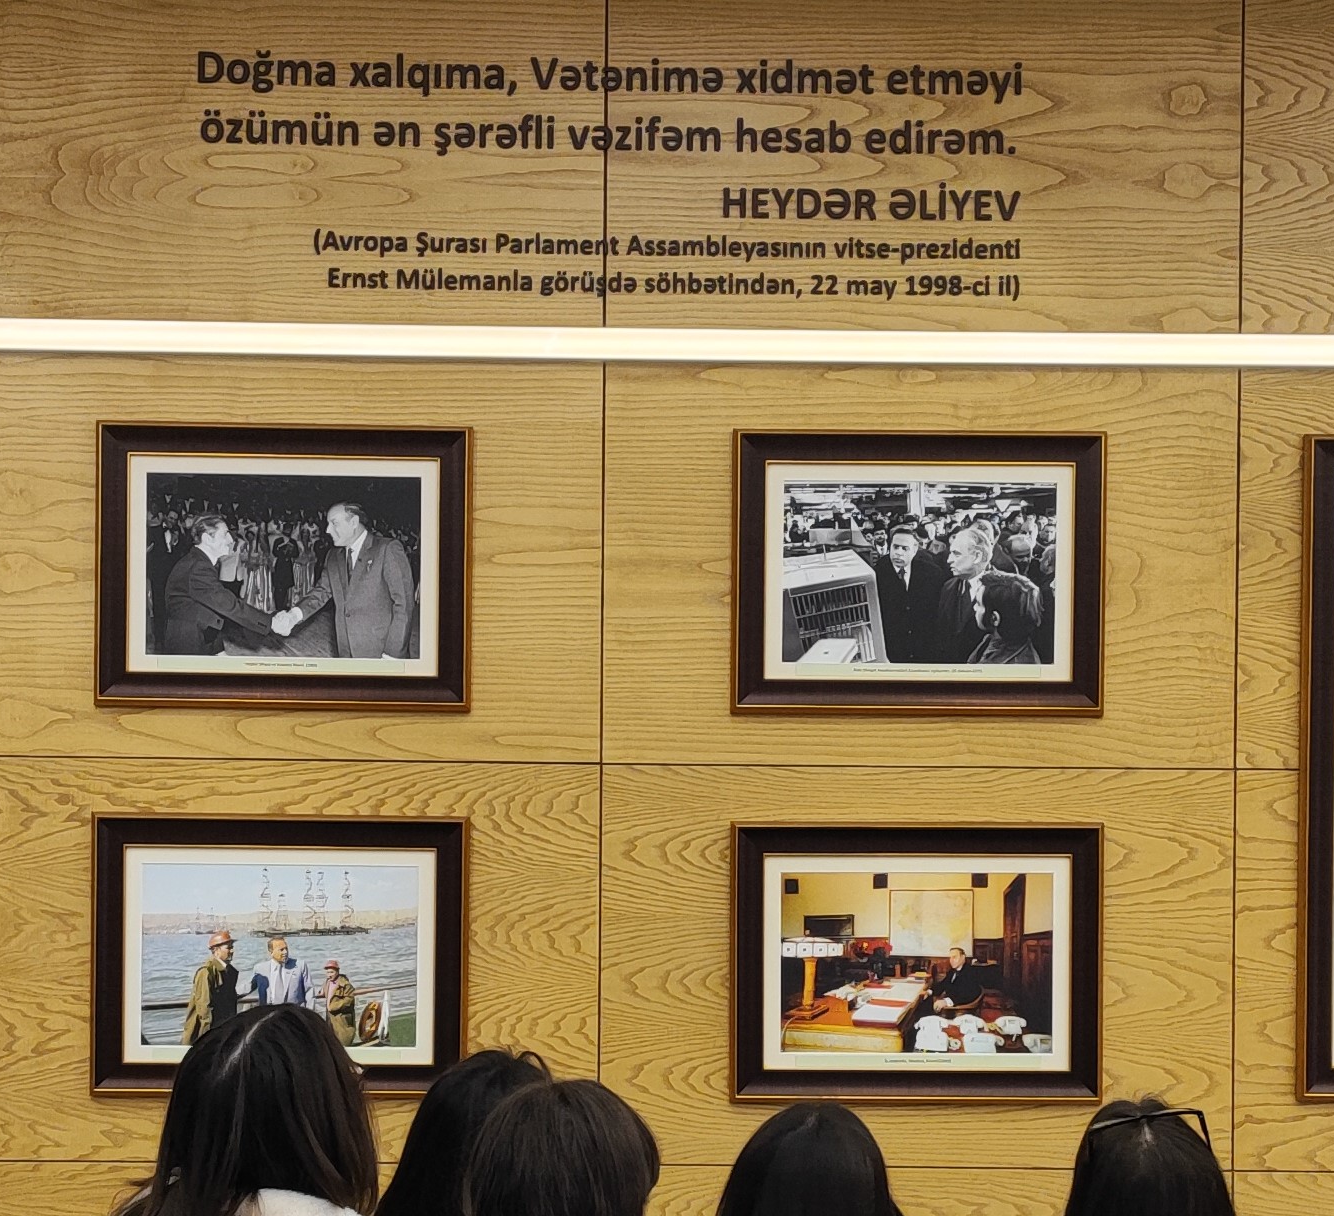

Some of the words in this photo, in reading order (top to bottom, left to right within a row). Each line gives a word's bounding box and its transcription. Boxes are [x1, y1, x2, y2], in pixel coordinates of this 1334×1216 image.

[197, 49, 336, 94] Doğma
[349, 52, 517, 98] xalqıma,
[530, 56, 724, 93] Vətənimə
[735, 58, 875, 95] xidmət
[886, 61, 1023, 105] etməyi
[200, 108, 359, 146] özümün
[373, 121, 421, 148] ən
[434, 114, 555, 157] şərəfli
[567, 114, 722, 152] vəzifəm
[736, 117, 852, 154] hesab
[864, 119, 1016, 155] edirəm.
[722, 187, 877, 221] HEYDƏR
[889, 181, 1021, 222] ƏLİYEV
[313, 228, 408, 258] (Avropa
[415, 231, 487, 258] Şurası
[495, 232, 620, 256] Parlament
[626, 234, 826, 262] Assambleyasının
[833, 237, 1021, 265] vitse-prezidenti
[328, 267, 389, 289] Ernst
[396, 267, 533, 292] Mülemanla
[540, 270, 637, 298] görüşdə
[644, 271, 802, 299] söhbətindən,
[810, 274, 839, 295] 22
[846, 279, 897, 301] may
[905, 274, 991, 297] 1998-ci
[998, 274, 1020, 302] il)
